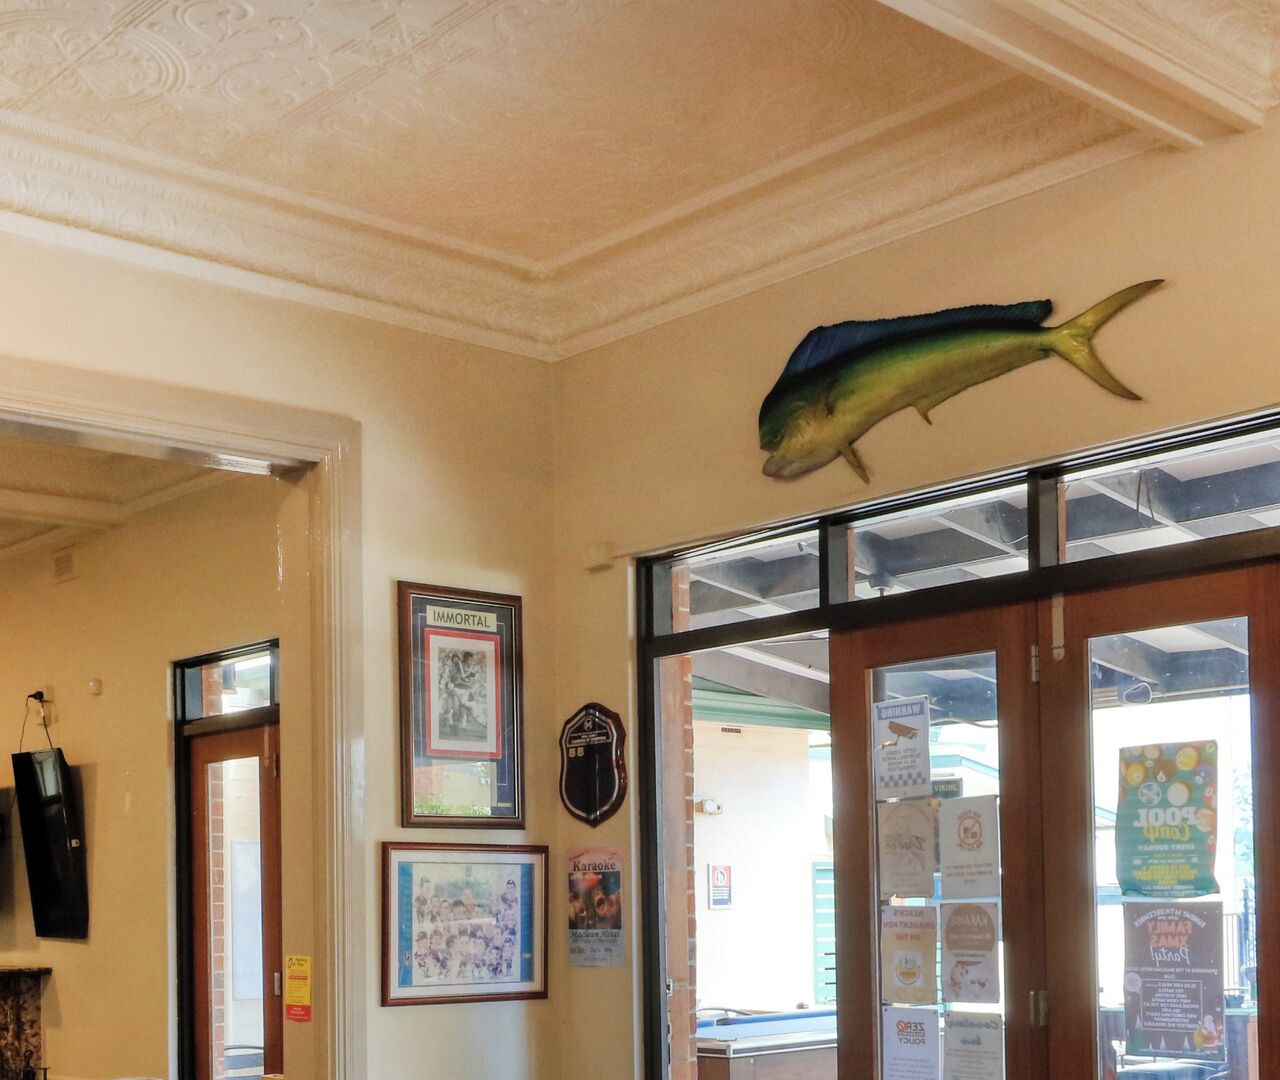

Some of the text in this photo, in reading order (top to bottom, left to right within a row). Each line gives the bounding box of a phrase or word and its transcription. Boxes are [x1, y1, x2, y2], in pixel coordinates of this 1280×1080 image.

[433, 609, 491, 628] IMMORTAL
[934, 784, 957, 792] VIKING
[573, 860, 617, 872] Karaoke
[570, 930, 620, 938] Maclean Hotel
